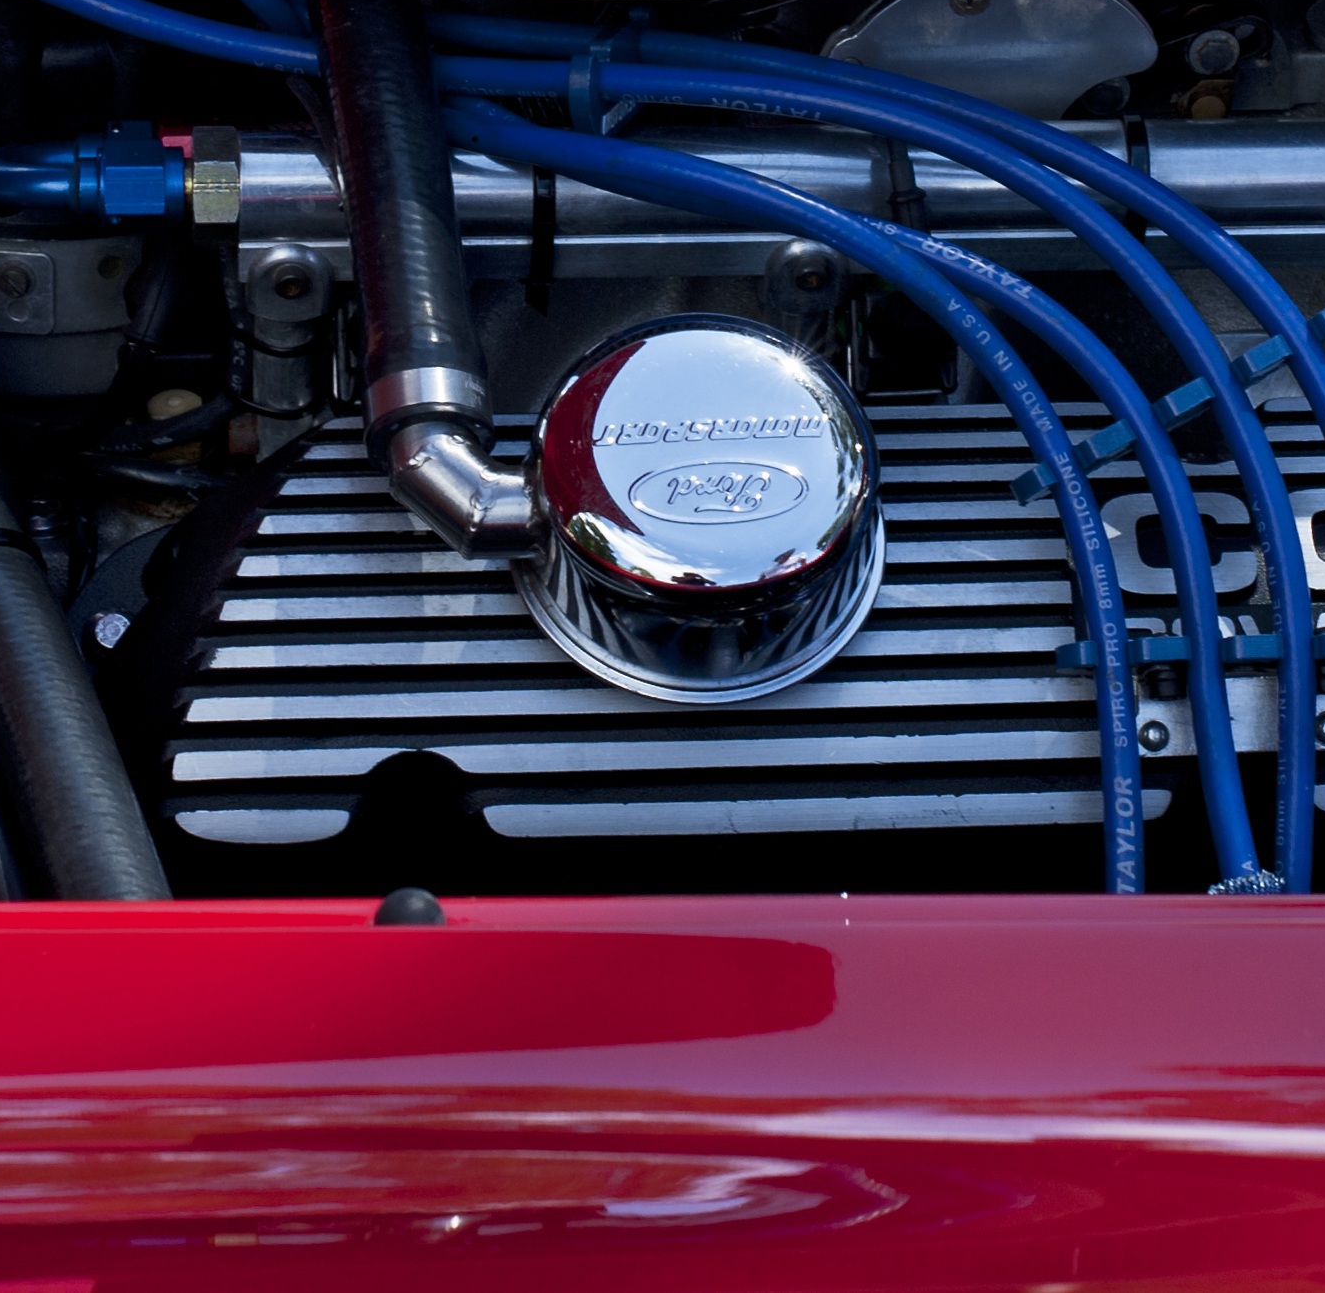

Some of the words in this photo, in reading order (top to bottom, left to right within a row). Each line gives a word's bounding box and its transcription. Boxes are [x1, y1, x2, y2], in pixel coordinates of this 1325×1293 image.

[921, 236, 1034, 300] TAYLOR
[993, 349, 1014, 372] IN
[1013, 379, 1054, 433] MADE
[666, 470, 772, 514] Ford
[1057, 451, 1100, 551] SILICONE
[1095, 563, 1113, 609] 8mm
[1105, 621, 1121, 668] PRO
[1110, 679, 1129, 748] SPIRO
[1113, 776, 1137, 894] TAYLOR
